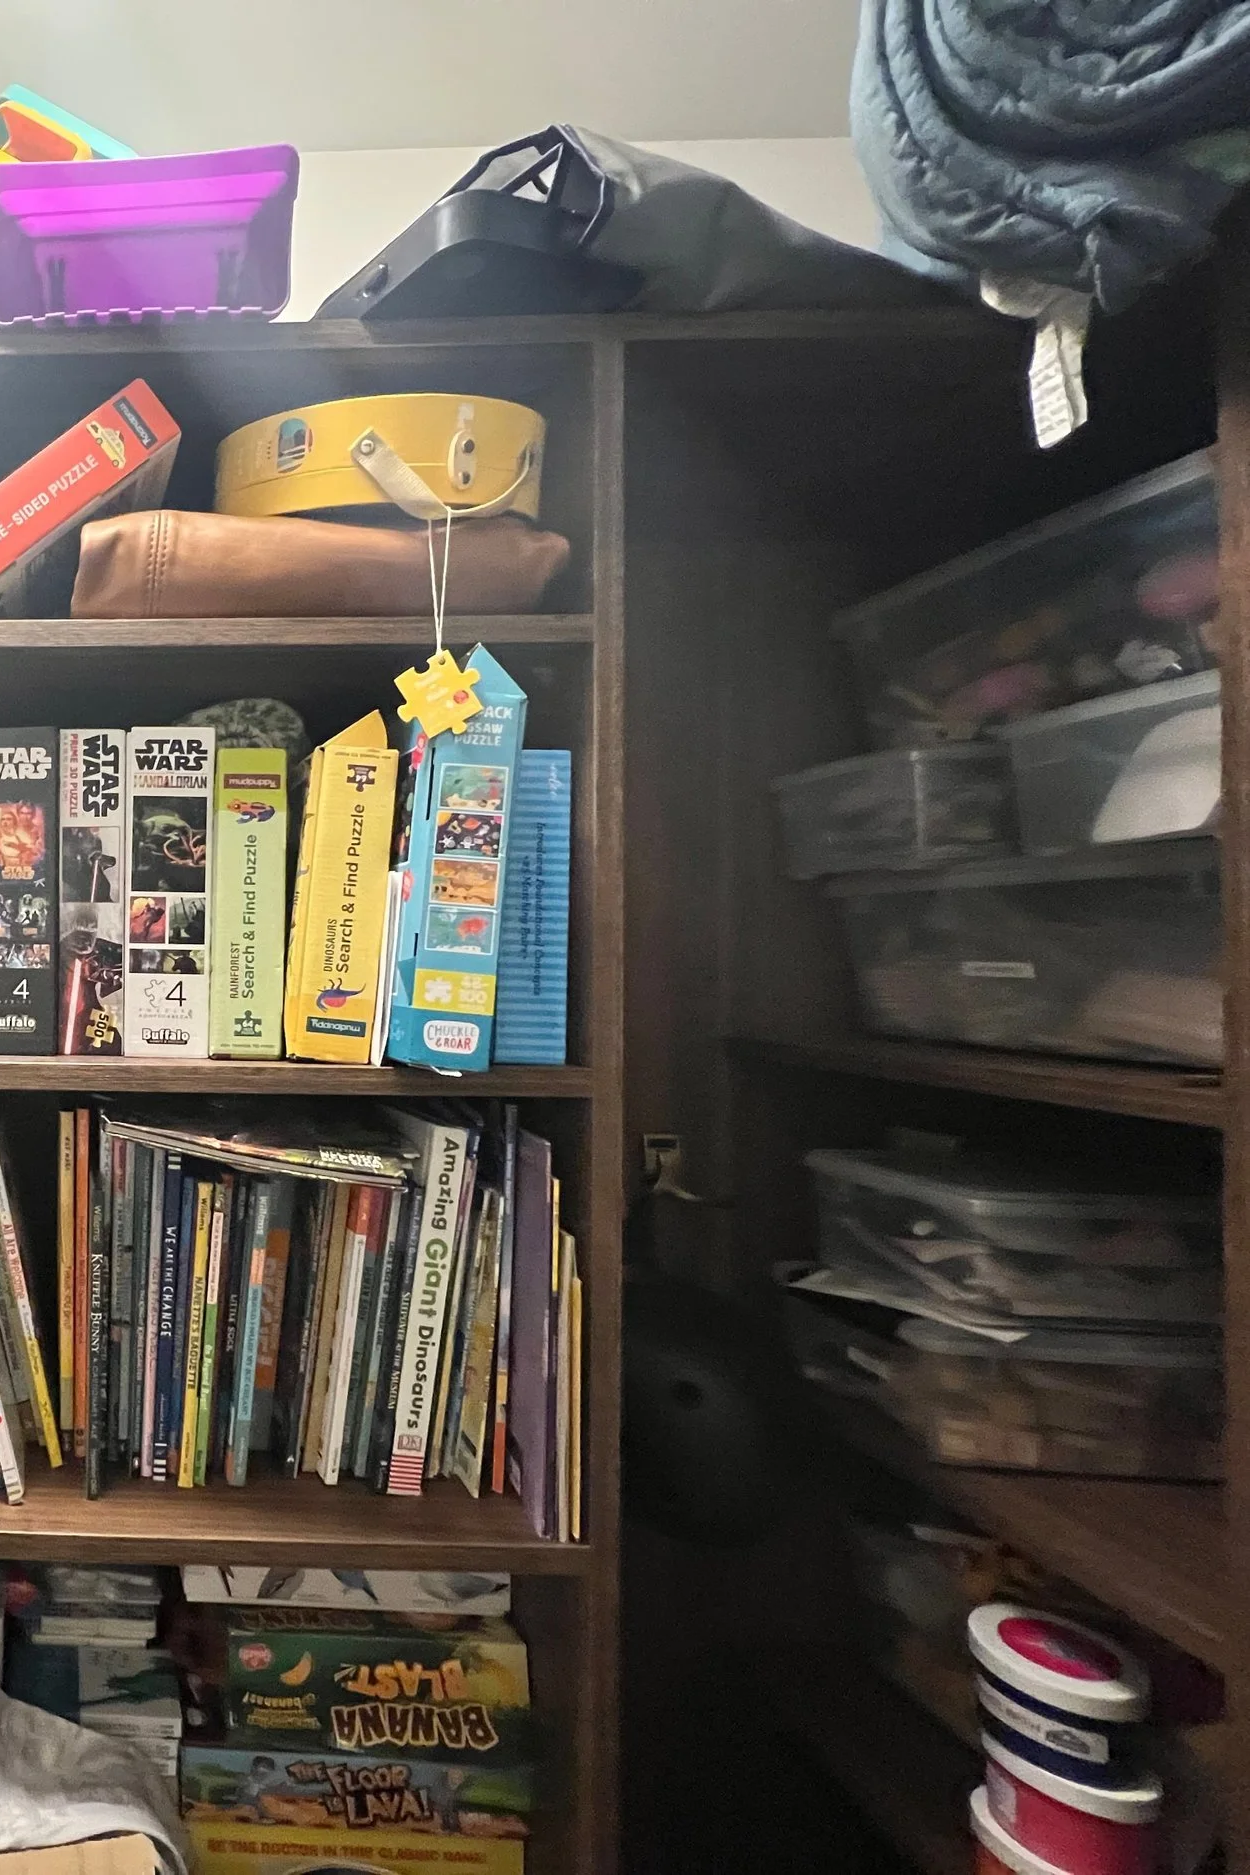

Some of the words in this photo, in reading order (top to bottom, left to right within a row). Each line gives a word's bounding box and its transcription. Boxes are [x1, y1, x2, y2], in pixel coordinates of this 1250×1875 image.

[47, 453, 99, 499] PUZZLE
[69, 733, 79, 763] PRIME
[135, 739, 208, 755] STAR
[454, 735, 502, 746] PUZZLE
[69, 766, 78, 779] 3D
[82, 734, 101, 817] WARS
[101, 734, 120, 817] STAR
[135, 756, 208, 771] WARS
[134, 775, 207, 789] MANDALORIAN
[68, 783, 78, 818] PUZZLE
[348, 803, 366, 857] Puzzle
[244, 834, 257, 886] Puzzle
[343, 862, 360, 898] Find
[243, 891, 256, 925] Find
[341, 902, 355, 914] &
[243, 930, 255, 941] &
[323, 918, 338, 972] DINOSAURS
[336, 918, 354, 973] Search
[230, 942, 241, 999] RAINFOREST
[242, 945, 255, 999] Search
[12, 978, 30, 1000] 4
[165, 980, 187, 1007] 4
[94, 1013, 109, 1038] 500
[141, 1028, 190, 1041] Buffalo
[427, 1025, 477, 1041] CHUCKLE
[443, 1038, 472, 1050] ROAR
[431, 1136, 460, 1231] Amazing
[2, 1223, 14, 1235] All
[92, 1205, 103, 1243] Willems
[198, 1197, 209, 1232] Willems
[255, 1195, 268, 1236] Willems
[6, 1239, 18, 1255] Are
[165, 1226, 178, 1244] WE
[165, 1247, 175, 1264] ARE
[11, 1258, 29, 1300] Welcome
[90, 1252, 105, 1308] KNUFFLE
[165, 1266, 174, 1282] THE
[418, 1238, 449, 1318] Giant
[159, 1285, 175, 1337] CHANGE
[228, 1293, 238, 1322] LITTLE
[395, 1291, 412, 1341] SLEEPOVER
[90, 1311, 104, 1354] BUNNY
[226, 1325, 236, 1353] SOCK
[187, 1336, 200, 1390] BAGUETTE
[406, 1324, 436, 1430] Dinosaurs
[387, 1369, 403, 1410] MUSEUM
[398, 1435, 422, 1449] DK
[346, 1659, 469, 1701] BLAST
[330, 1703, 499, 1751] BANANA
[286, 1760, 328, 1783] THE
[326, 1763, 412, 1795] FLOOR
[342, 1789, 434, 1828] LAVA!
[230, 1840, 257, 1854] THE
[261, 1841, 320, 1857] DOCTOR
[322, 1845, 337, 1857] IN
[340, 1845, 375, 1860] THIS
